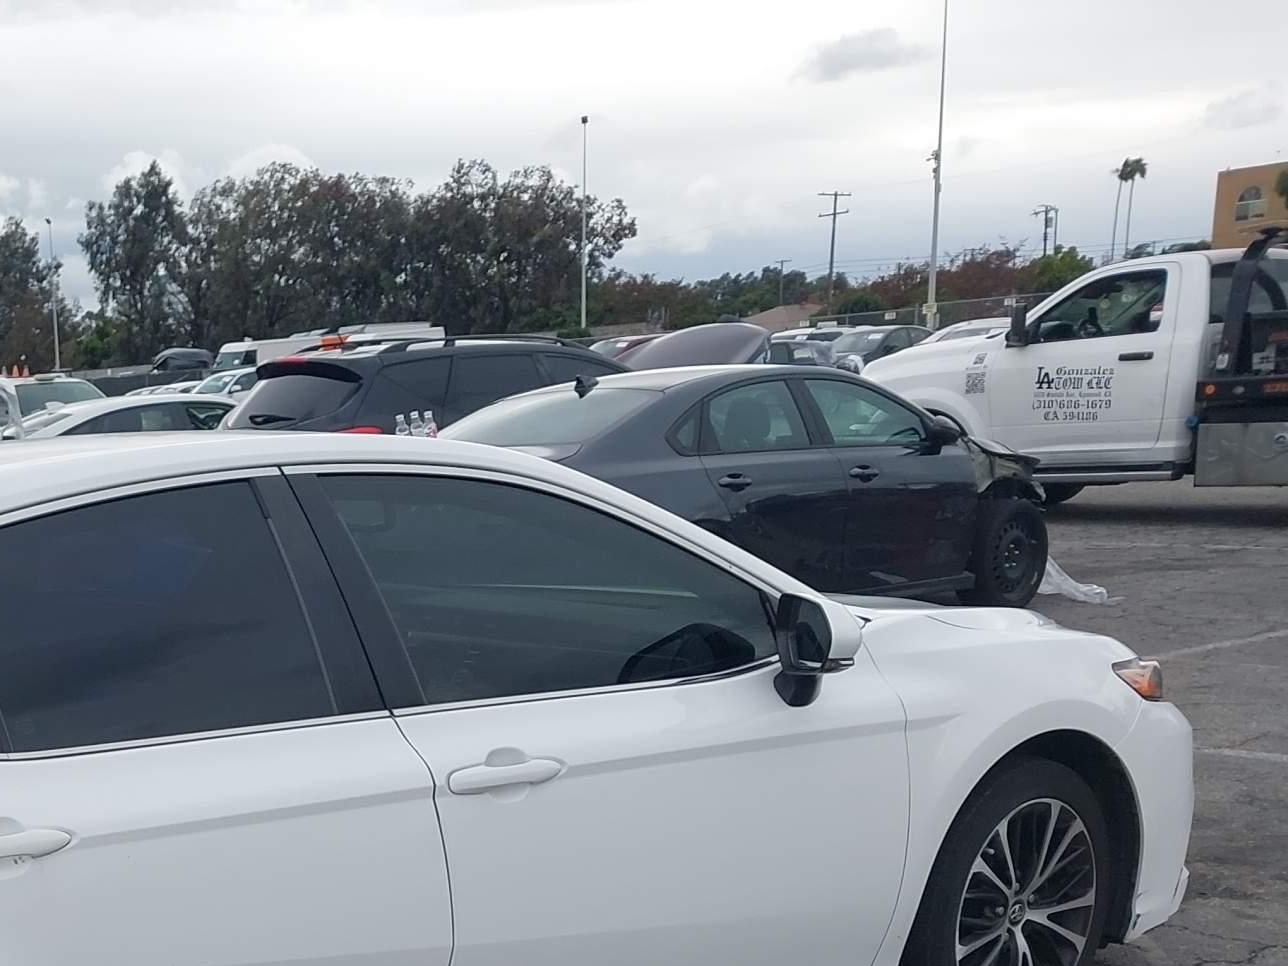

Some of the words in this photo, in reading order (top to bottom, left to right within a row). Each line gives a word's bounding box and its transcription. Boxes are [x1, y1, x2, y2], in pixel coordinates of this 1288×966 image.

[1056, 366, 1114, 376] Gonzalez
[1035, 366, 1054, 390] LA
[1054, 377, 1083, 390] TOW
[1087, 376, 1113, 390] LLC
[1043, 411, 1059, 421] CA
